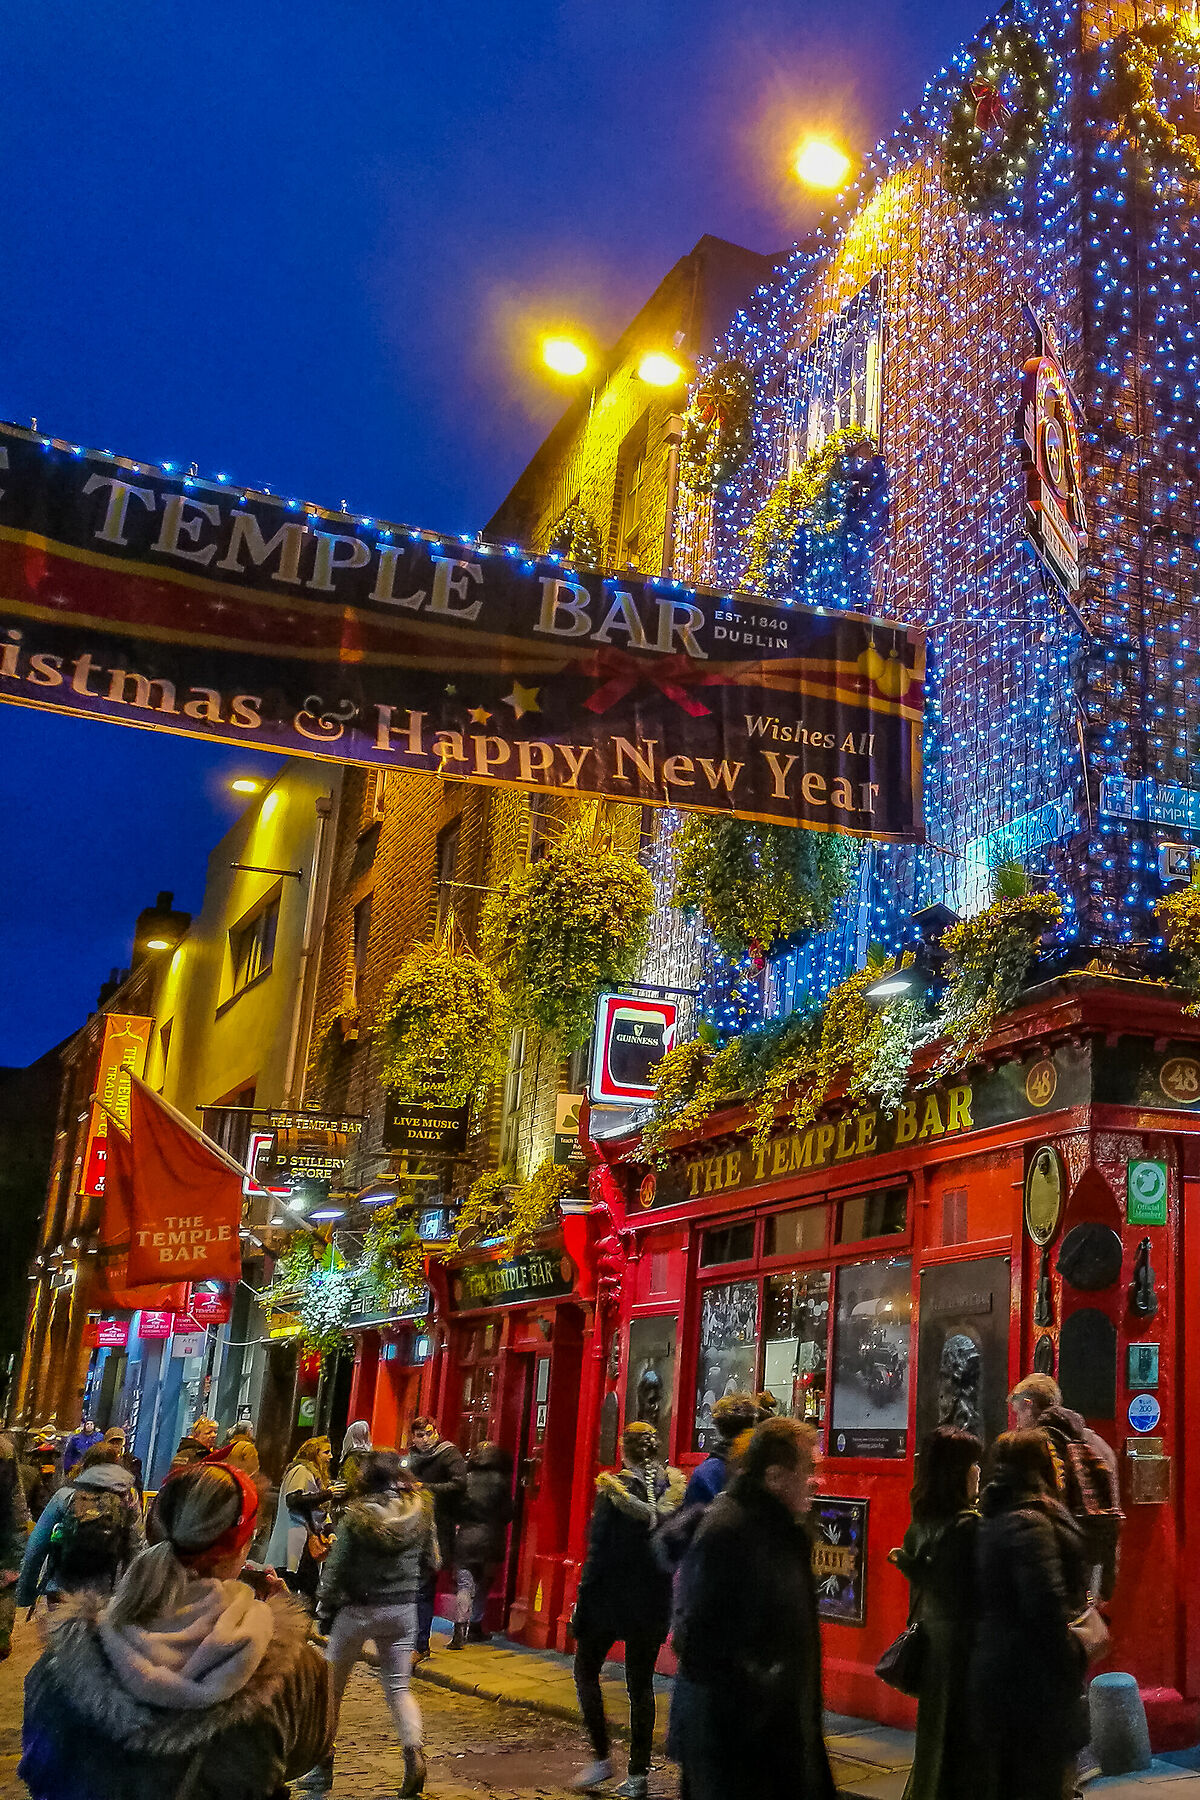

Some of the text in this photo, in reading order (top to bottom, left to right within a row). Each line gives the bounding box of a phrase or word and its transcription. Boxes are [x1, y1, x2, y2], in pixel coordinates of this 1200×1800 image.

[82, 473, 708, 660] TEMPLE BAR
[714, 611, 788, 631] EST.1840
[714, 626, 788, 649] DUBLIN
[744, 714, 875, 757] Wishes All
[294, 694, 359, 742] &
[372, 703, 592, 788] Happy
[610, 736, 745, 792] New
[760, 750, 880, 814] Year
[616, 1033, 659, 1047] GUINNESS
[1031, 1070, 1051, 1099] 48
[1170, 1062, 1198, 1092] 48
[270, 1116, 362, 1133] THE TEMPLE BAR
[393, 1117, 460, 1130] LIVE MUSIC
[407, 1129, 444, 1141] DAILY
[687, 1085, 975, 1196] THE TEMPLE BAR
[291, 1167, 333, 1179] STORE
[164, 1216, 205, 1229] THE
[136, 1225, 233, 1247] TEMPLE
[159, 1245, 208, 1263] BAR
